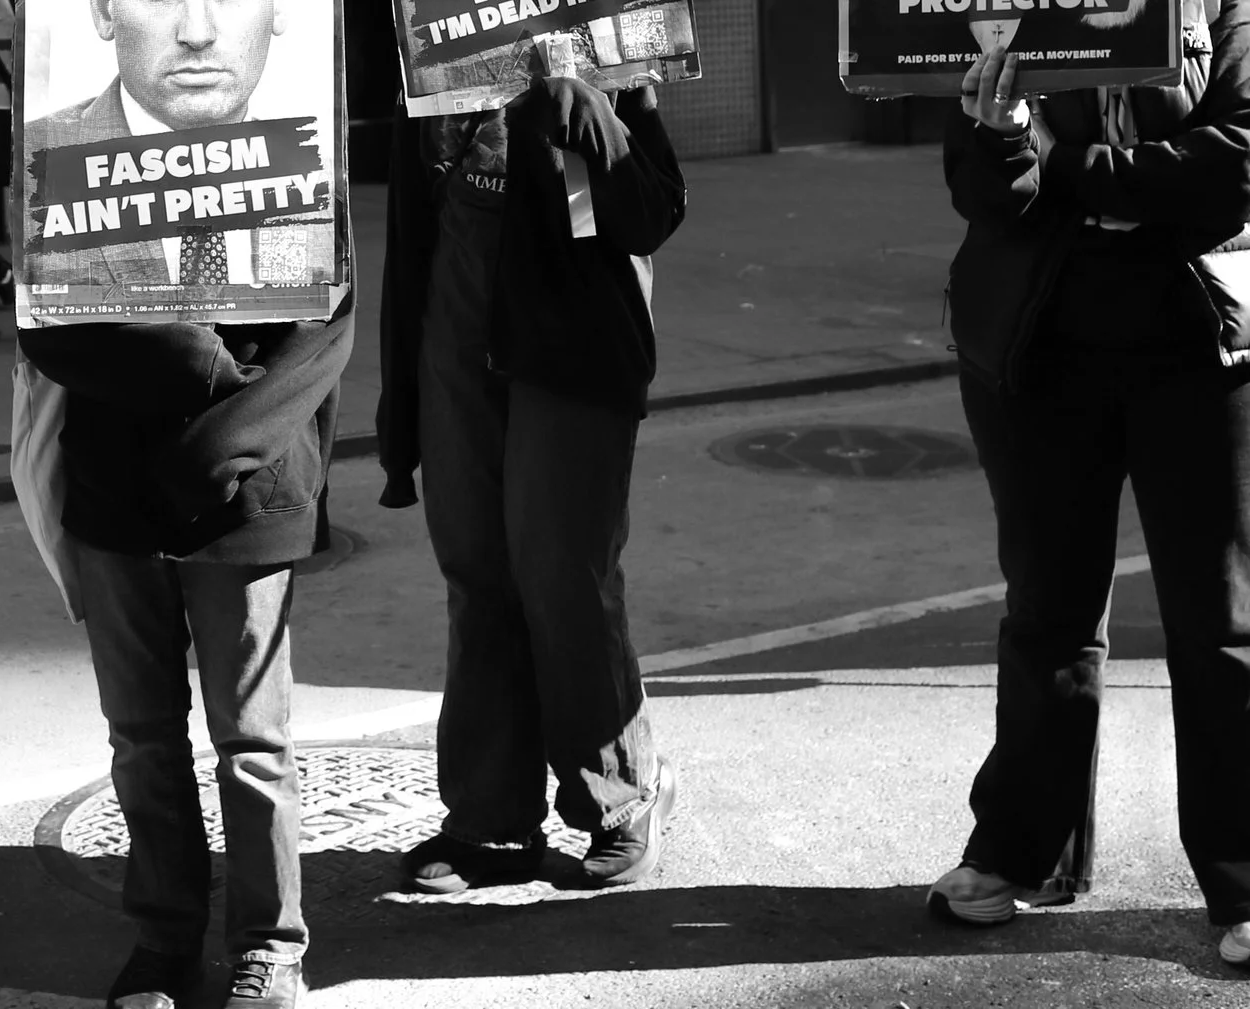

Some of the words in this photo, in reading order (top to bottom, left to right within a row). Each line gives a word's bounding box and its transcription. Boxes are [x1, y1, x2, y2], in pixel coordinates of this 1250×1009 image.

[429, 12, 477, 45] I'M
[897, 55, 923, 63] PAID
[925, 54, 947, 63] FOR
[948, 53, 963, 62] BY
[1047, 49, 1111, 60] MOVEMENT
[85, 135, 270, 189] FASCISM
[42, 192, 155, 239] AIN'T
[164, 173, 320, 223] PRETTY
[48, 306, 57, 314] W
